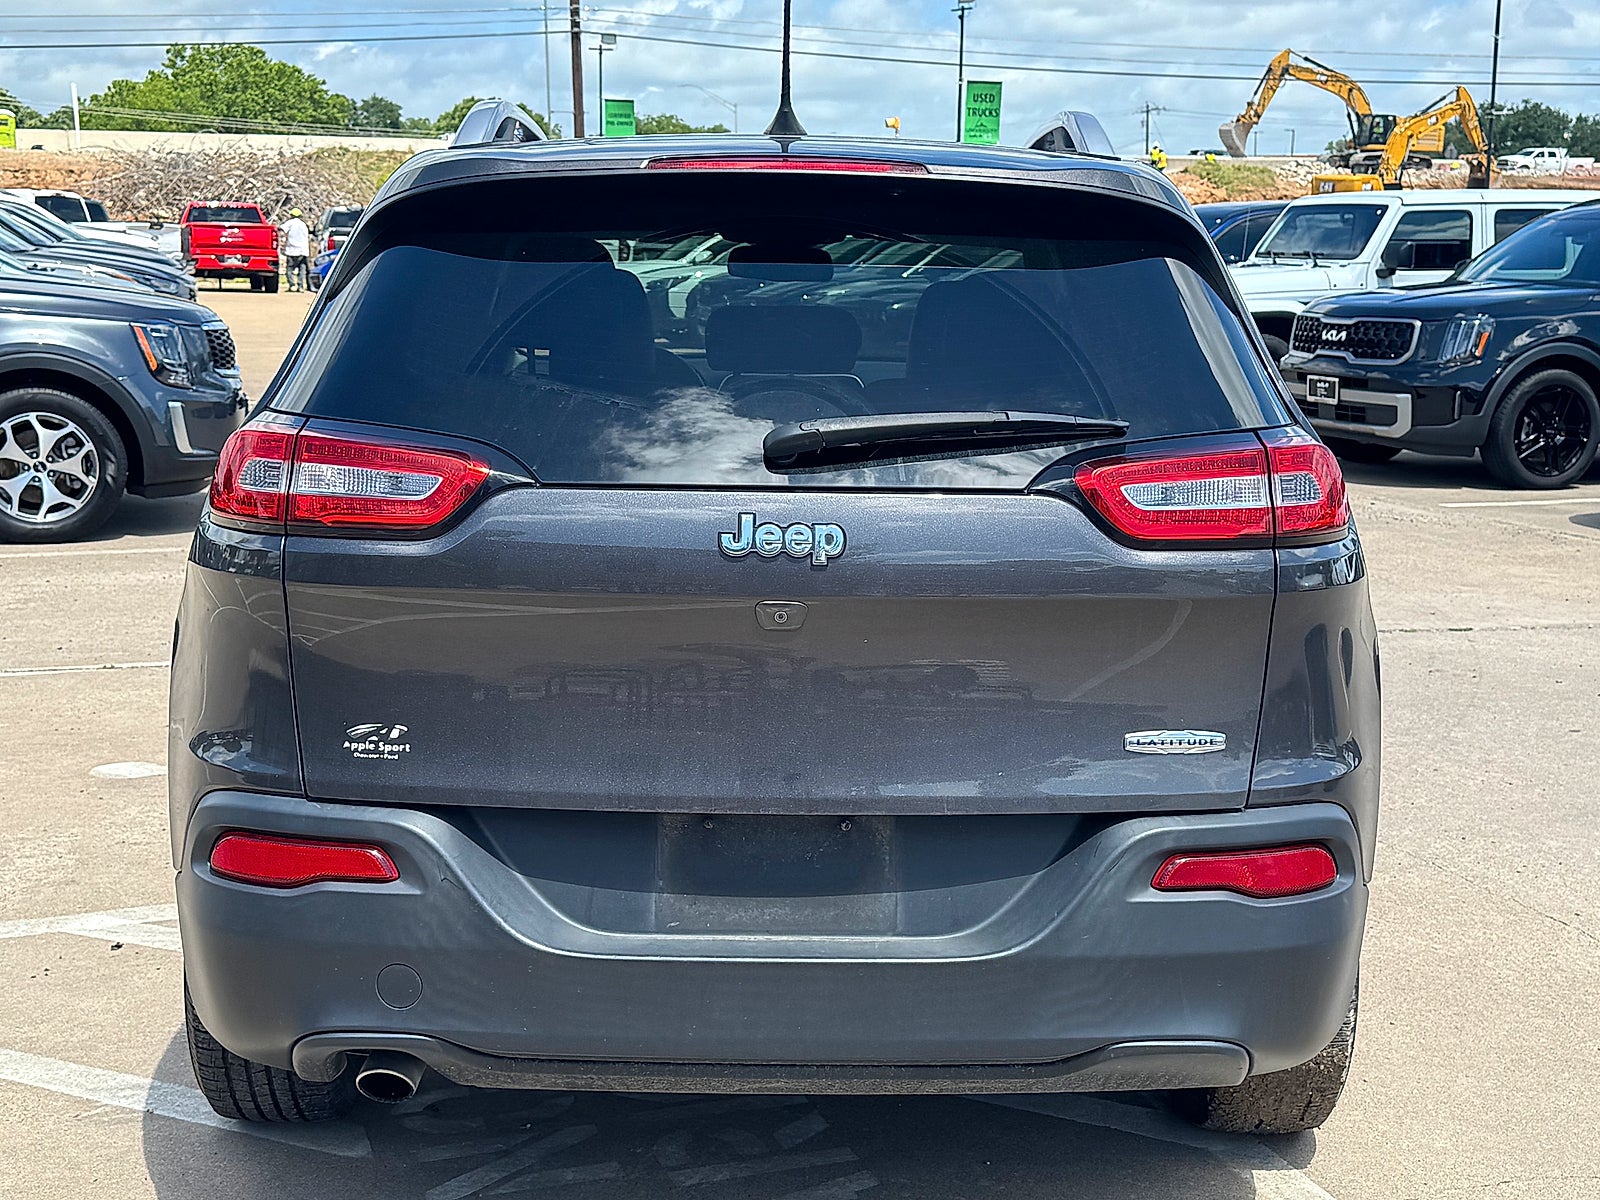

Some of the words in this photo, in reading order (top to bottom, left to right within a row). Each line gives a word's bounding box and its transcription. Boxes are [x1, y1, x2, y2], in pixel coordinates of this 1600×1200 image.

[973, 93, 995, 103] USED
[967, 107, 1000, 118] TRUCKS
[718, 511, 846, 566] Jeep
[343, 740, 376, 752] Apple
[378, 741, 411, 754] Sport
[1135, 738, 1219, 747] LATITUDE
